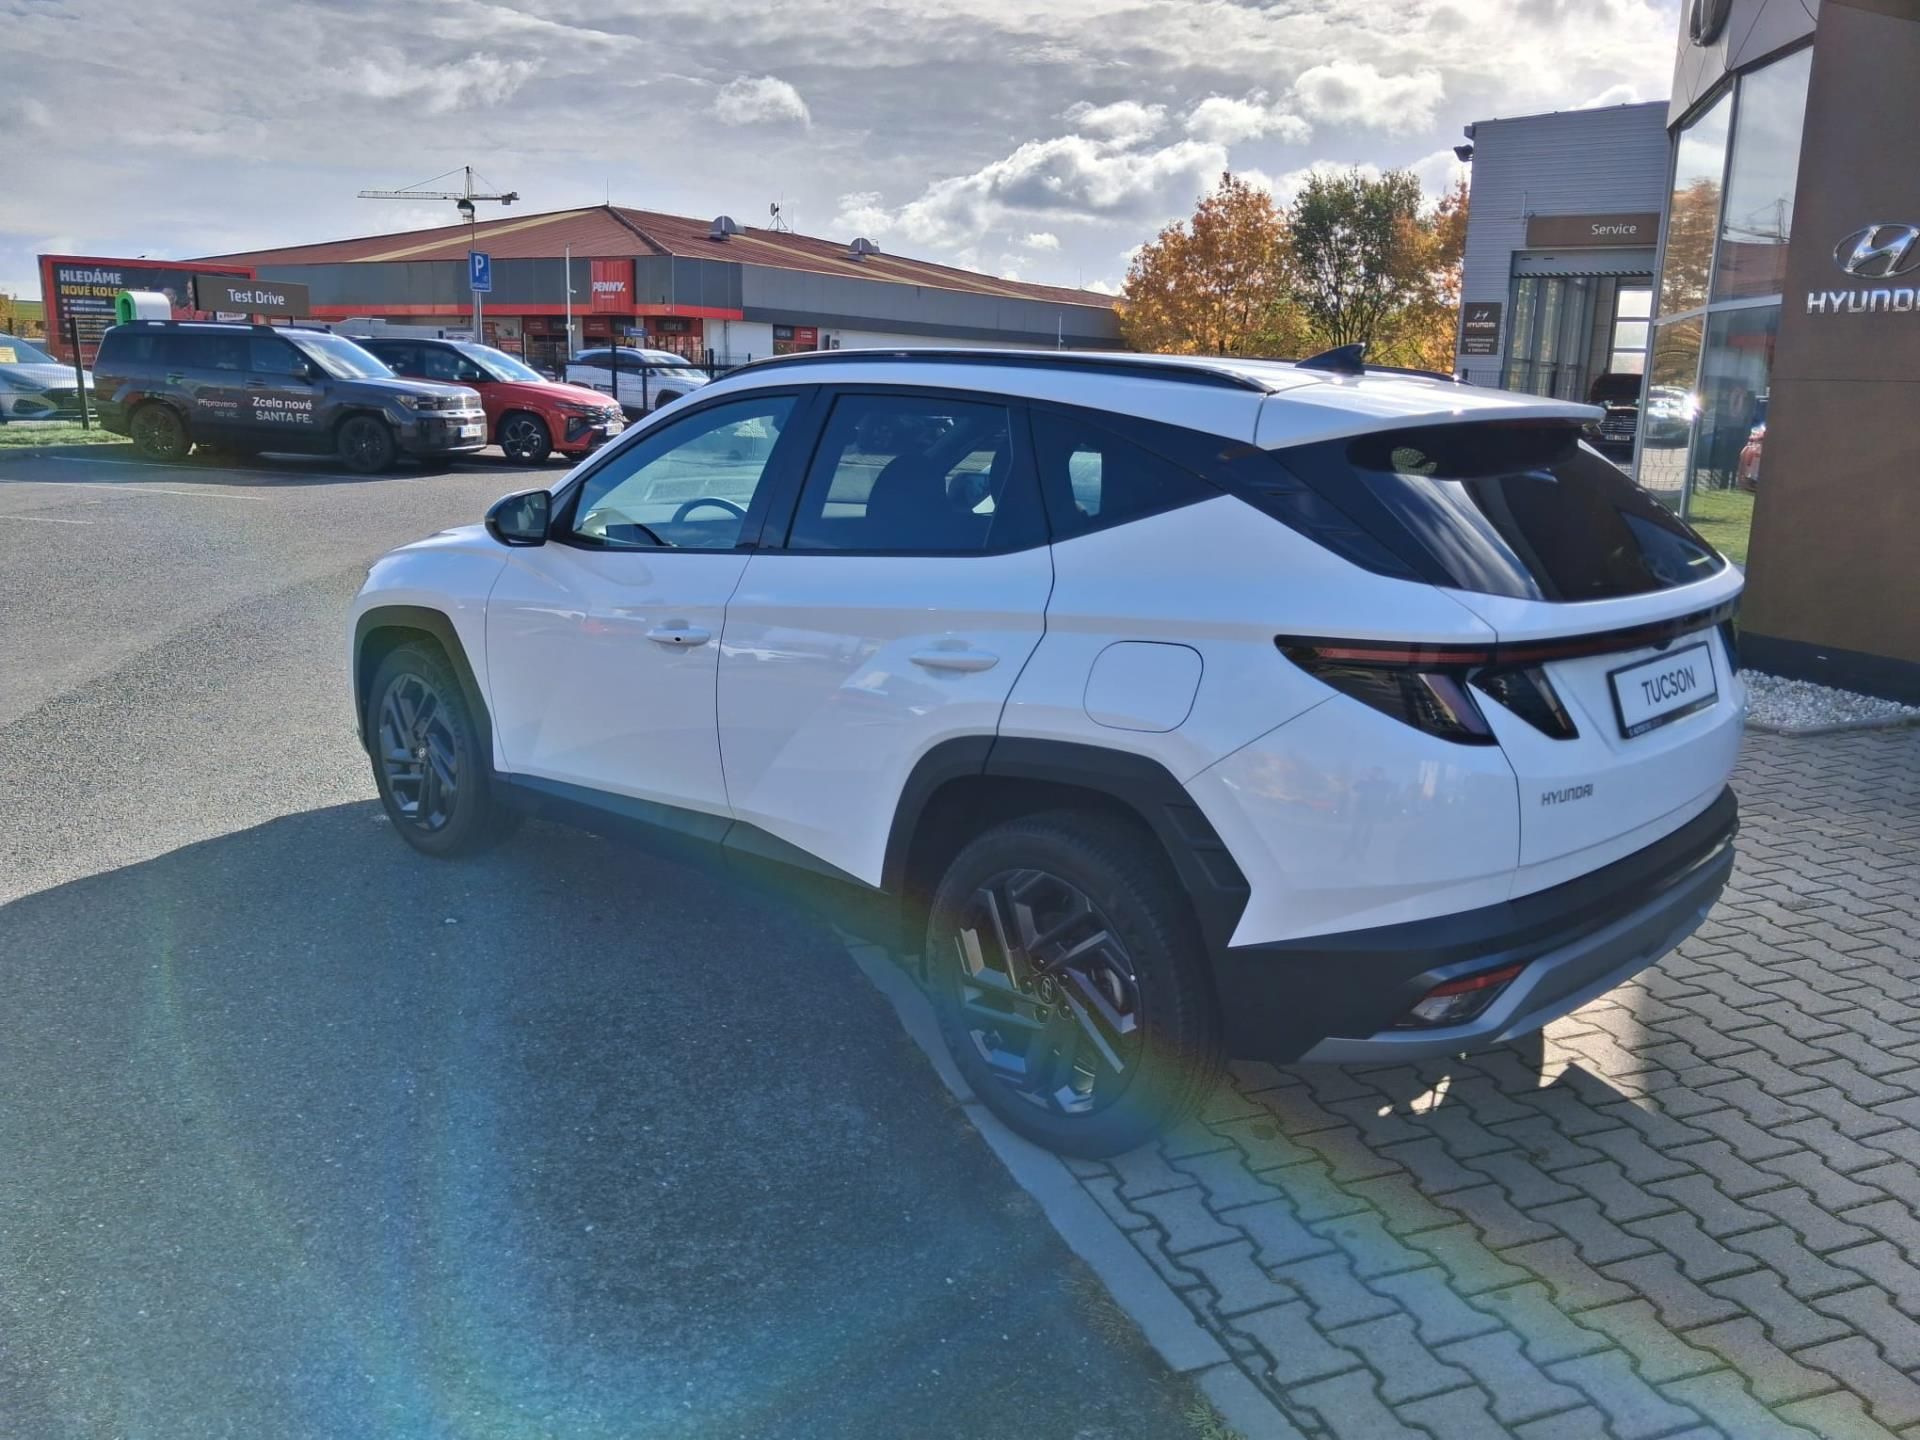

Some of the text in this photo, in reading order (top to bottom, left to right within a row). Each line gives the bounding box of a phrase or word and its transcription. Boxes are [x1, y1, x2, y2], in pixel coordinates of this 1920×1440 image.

[1591, 223, 1637, 236] Service
[475, 255, 485, 277] P
[60, 268, 122, 285] HLEDÁME
[61, 283, 91, 297] NOVÉ
[227, 288, 285, 305] Test Drive
[252, 396, 313, 410] Zcela nové
[255, 410, 294, 422] SANTA
[1641, 665, 1696, 706] TUCSON
[1541, 783, 1594, 806] HYUNDAI
